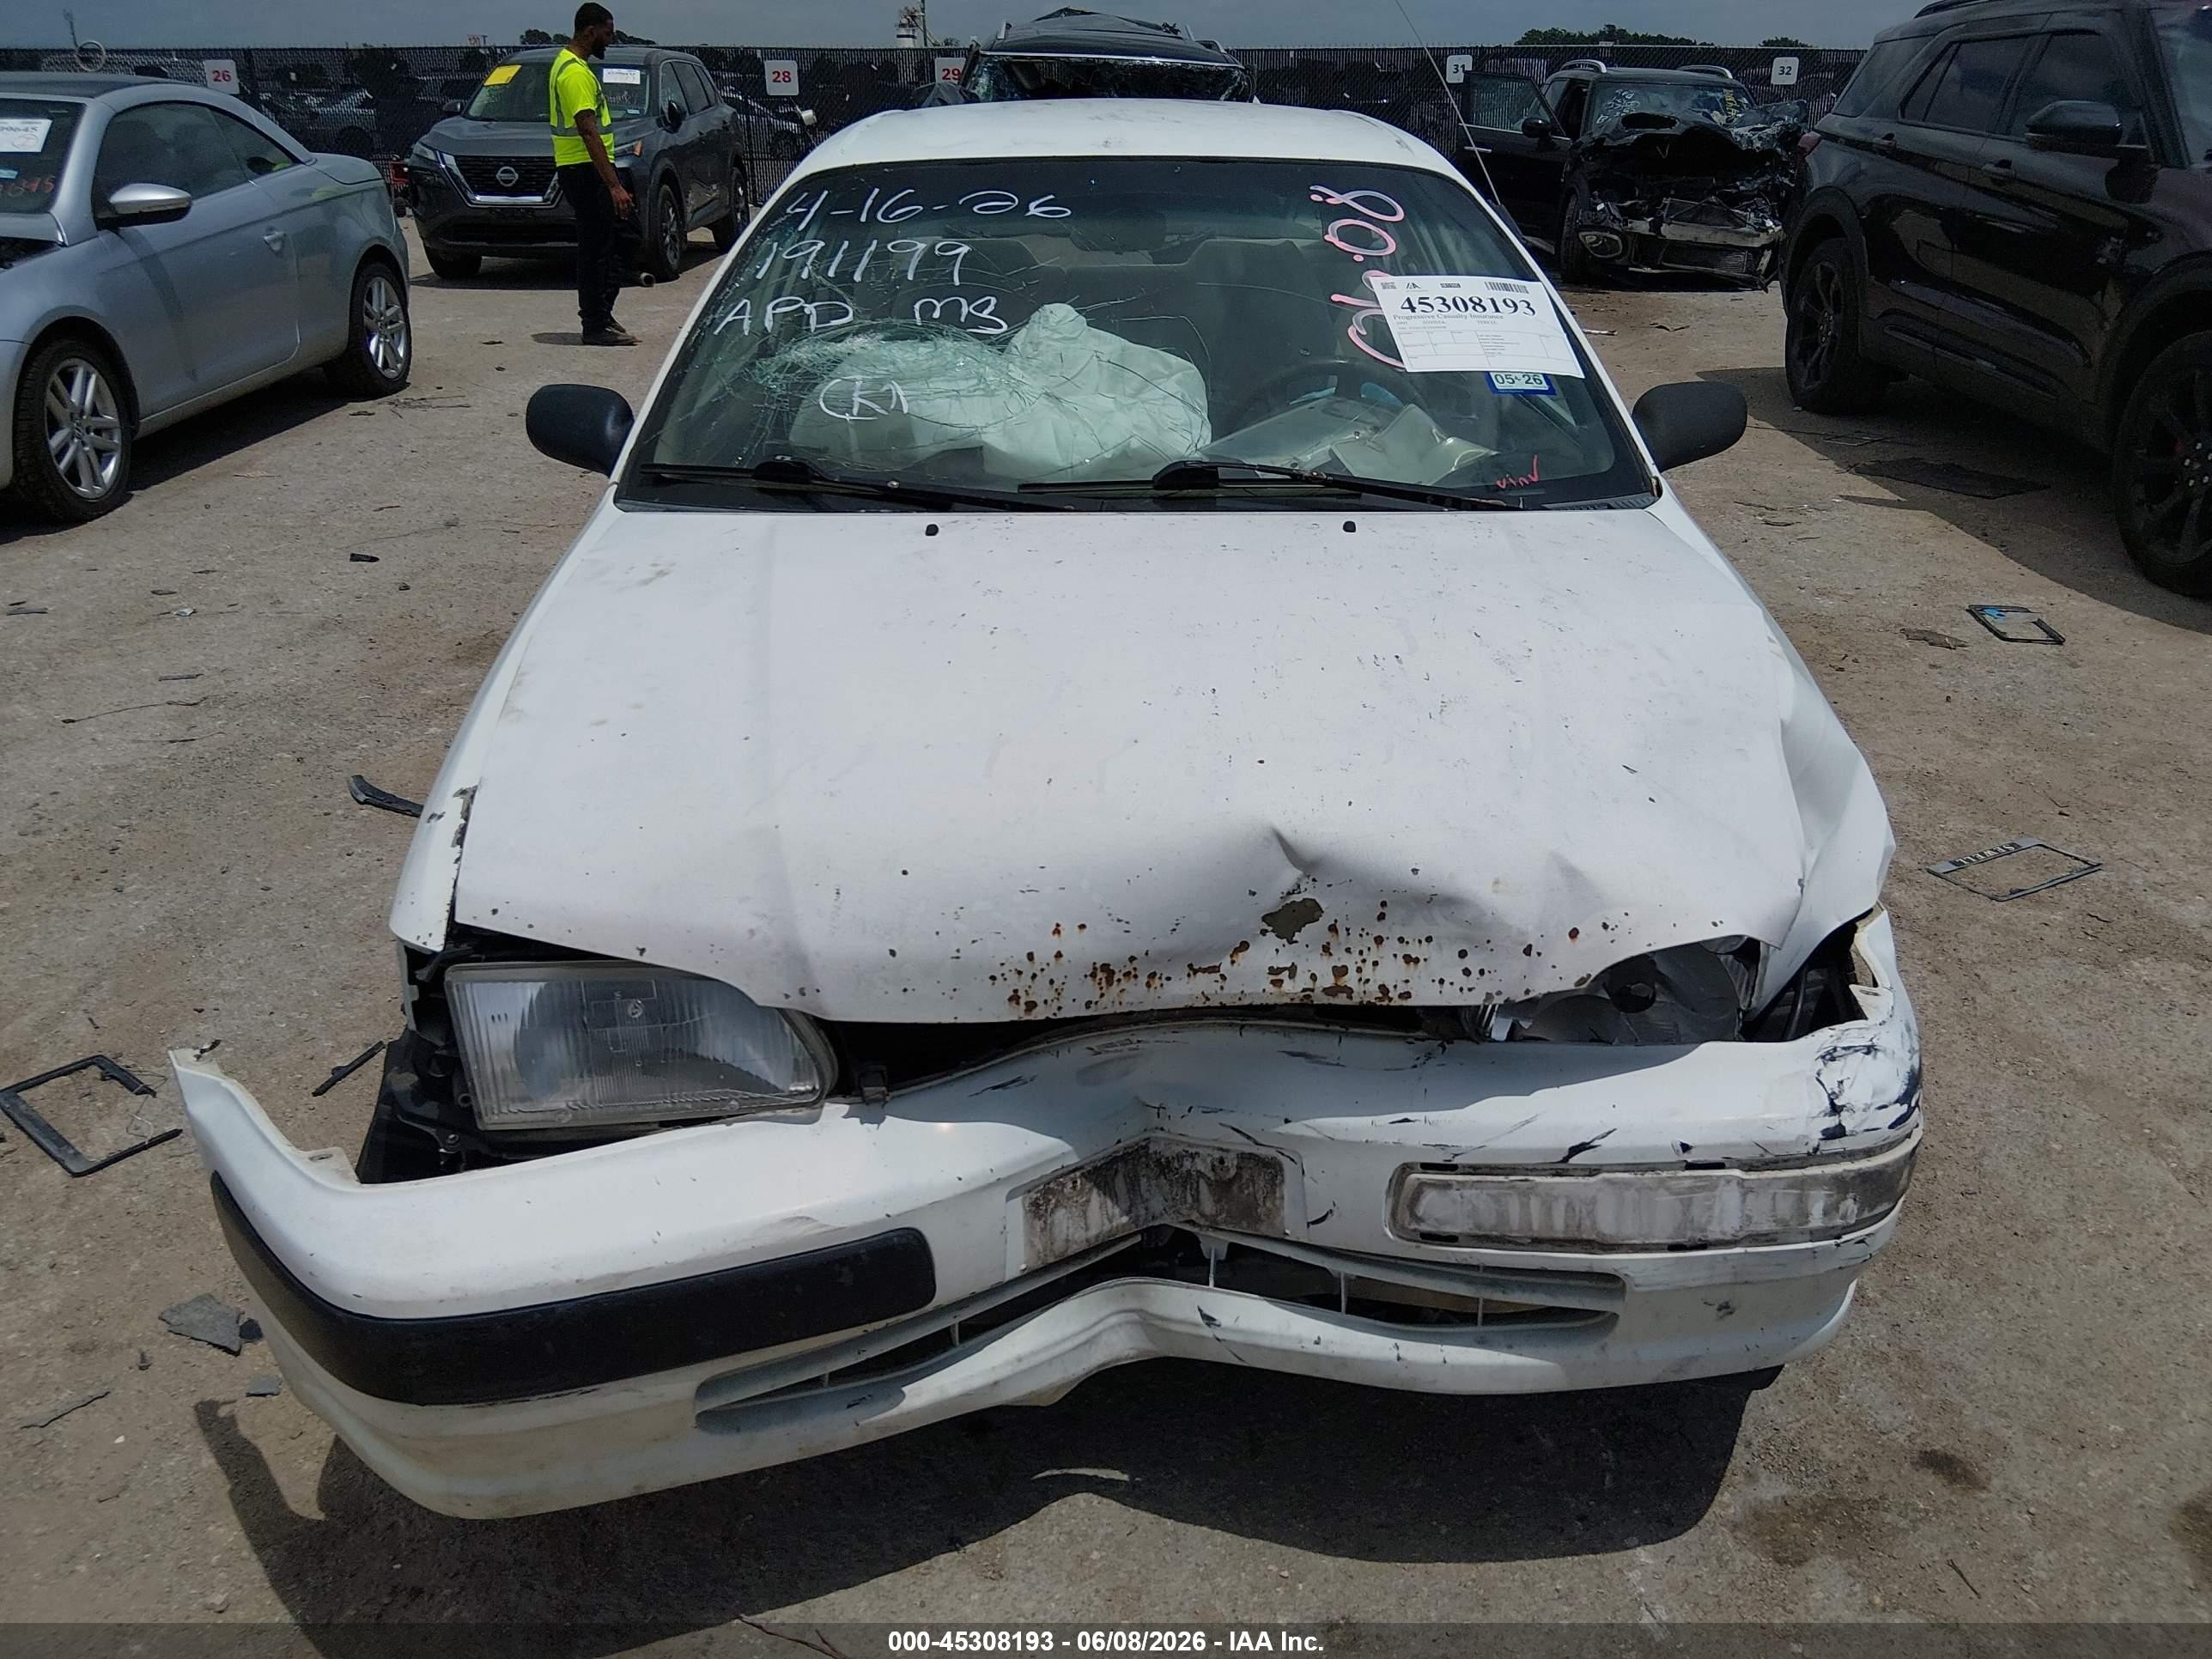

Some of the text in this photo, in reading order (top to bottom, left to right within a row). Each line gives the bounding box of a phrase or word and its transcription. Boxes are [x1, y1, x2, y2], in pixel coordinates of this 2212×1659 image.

[942, 68, 961, 81] 29
[1452, 64, 1466, 74] 31
[1778, 66, 1792, 76] 32
[212, 70, 231, 82] 26
[772, 70, 792, 83] 28
[786, 188, 1073, 231] 4-16-26
[755, 240, 973, 286] 191199
[1401, 295, 1536, 316] 45308193
[714, 296, 854, 336] APD
[1494, 374, 1543, 385] 05 26
[1955, 843, 2015, 865] SEWELL
